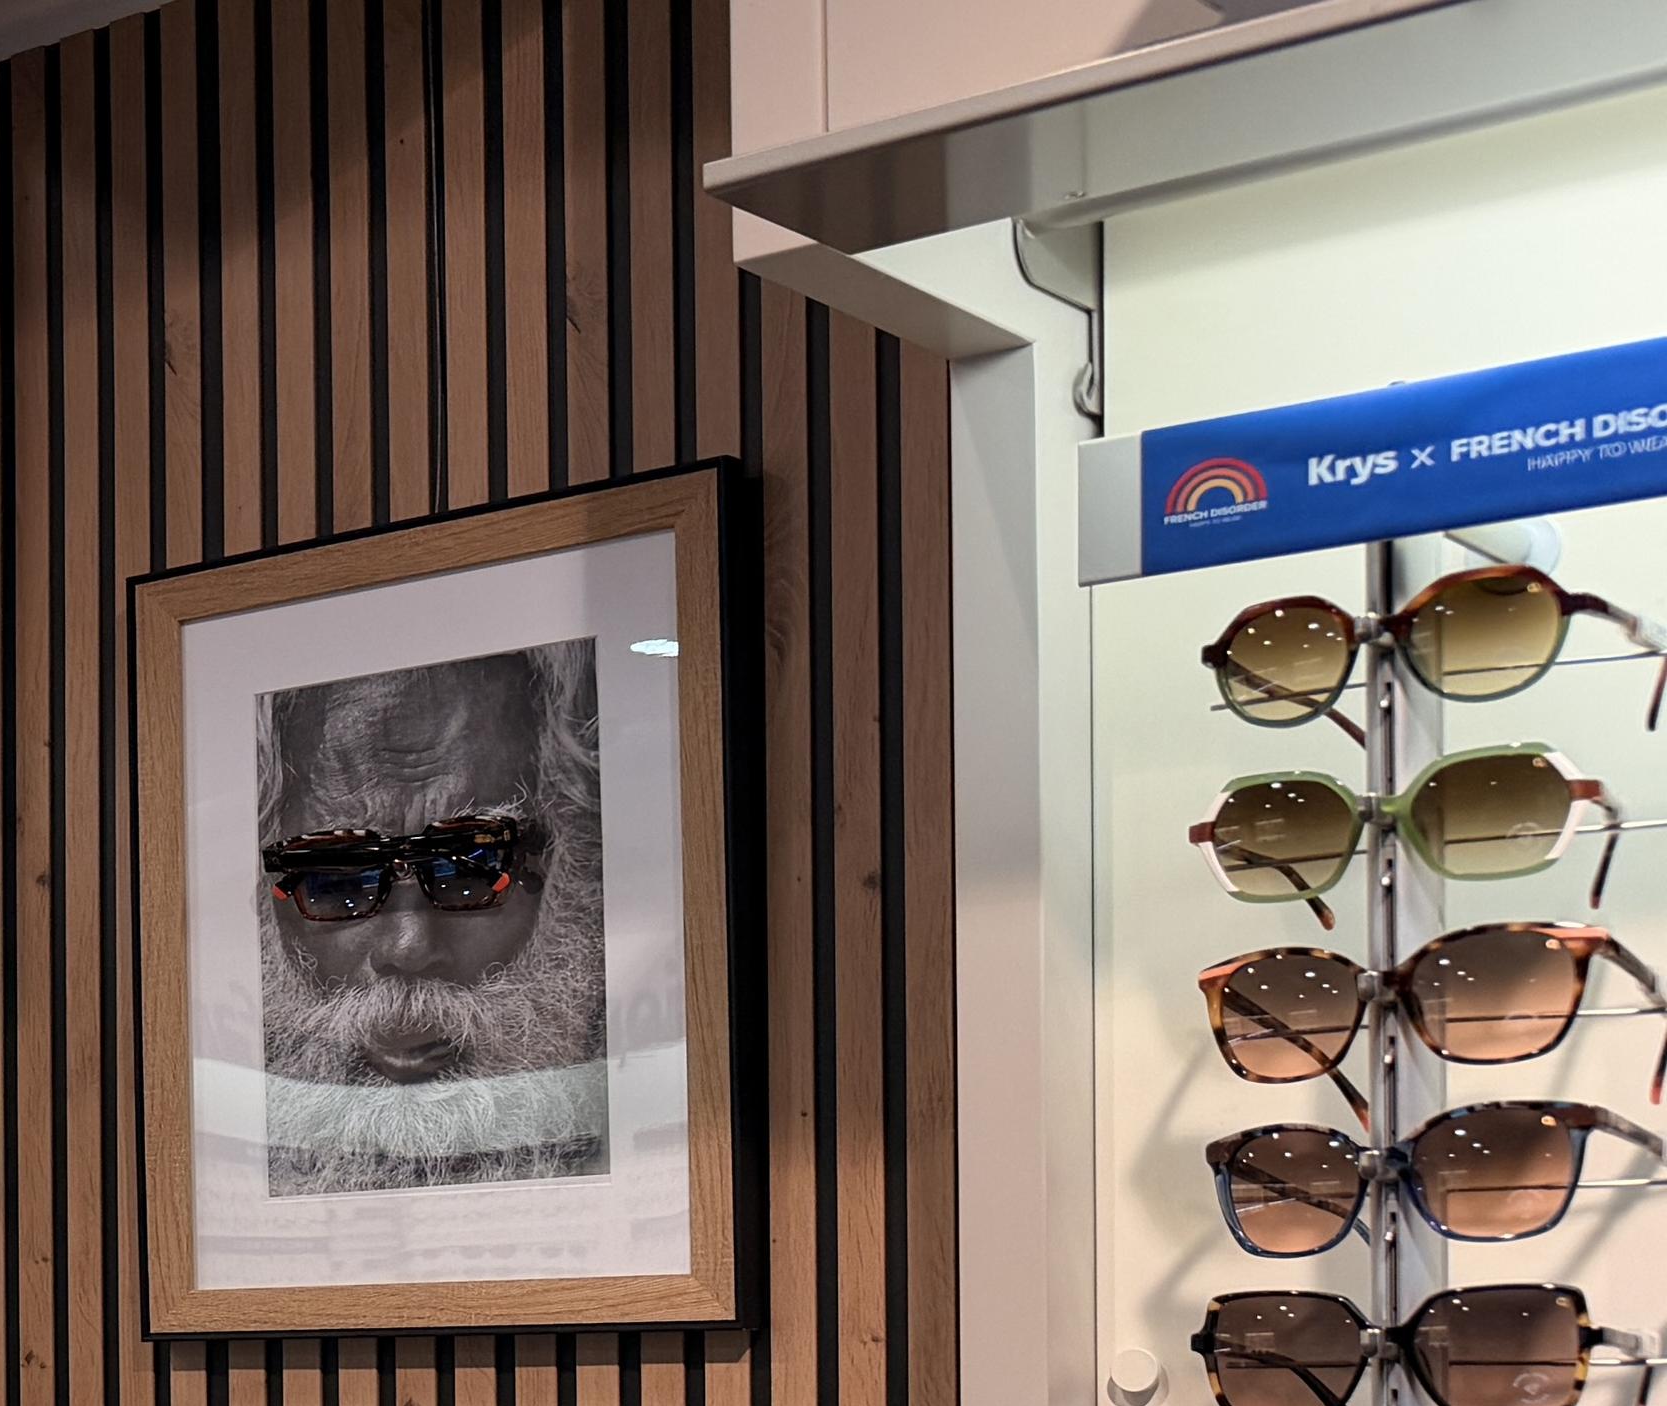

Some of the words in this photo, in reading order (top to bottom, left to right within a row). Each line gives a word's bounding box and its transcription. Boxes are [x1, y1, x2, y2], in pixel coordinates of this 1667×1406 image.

[1307, 449, 1398, 488] Krys
[1450, 418, 1586, 462] FRENCH
[1592, 403, 1667, 439] DISO
[1527, 448, 1593, 472] HAPPY
[1599, 441, 1627, 459] TO
[1163, 510, 1208, 525] FRENCH
[1210, 500, 1268, 518] DISORDER
